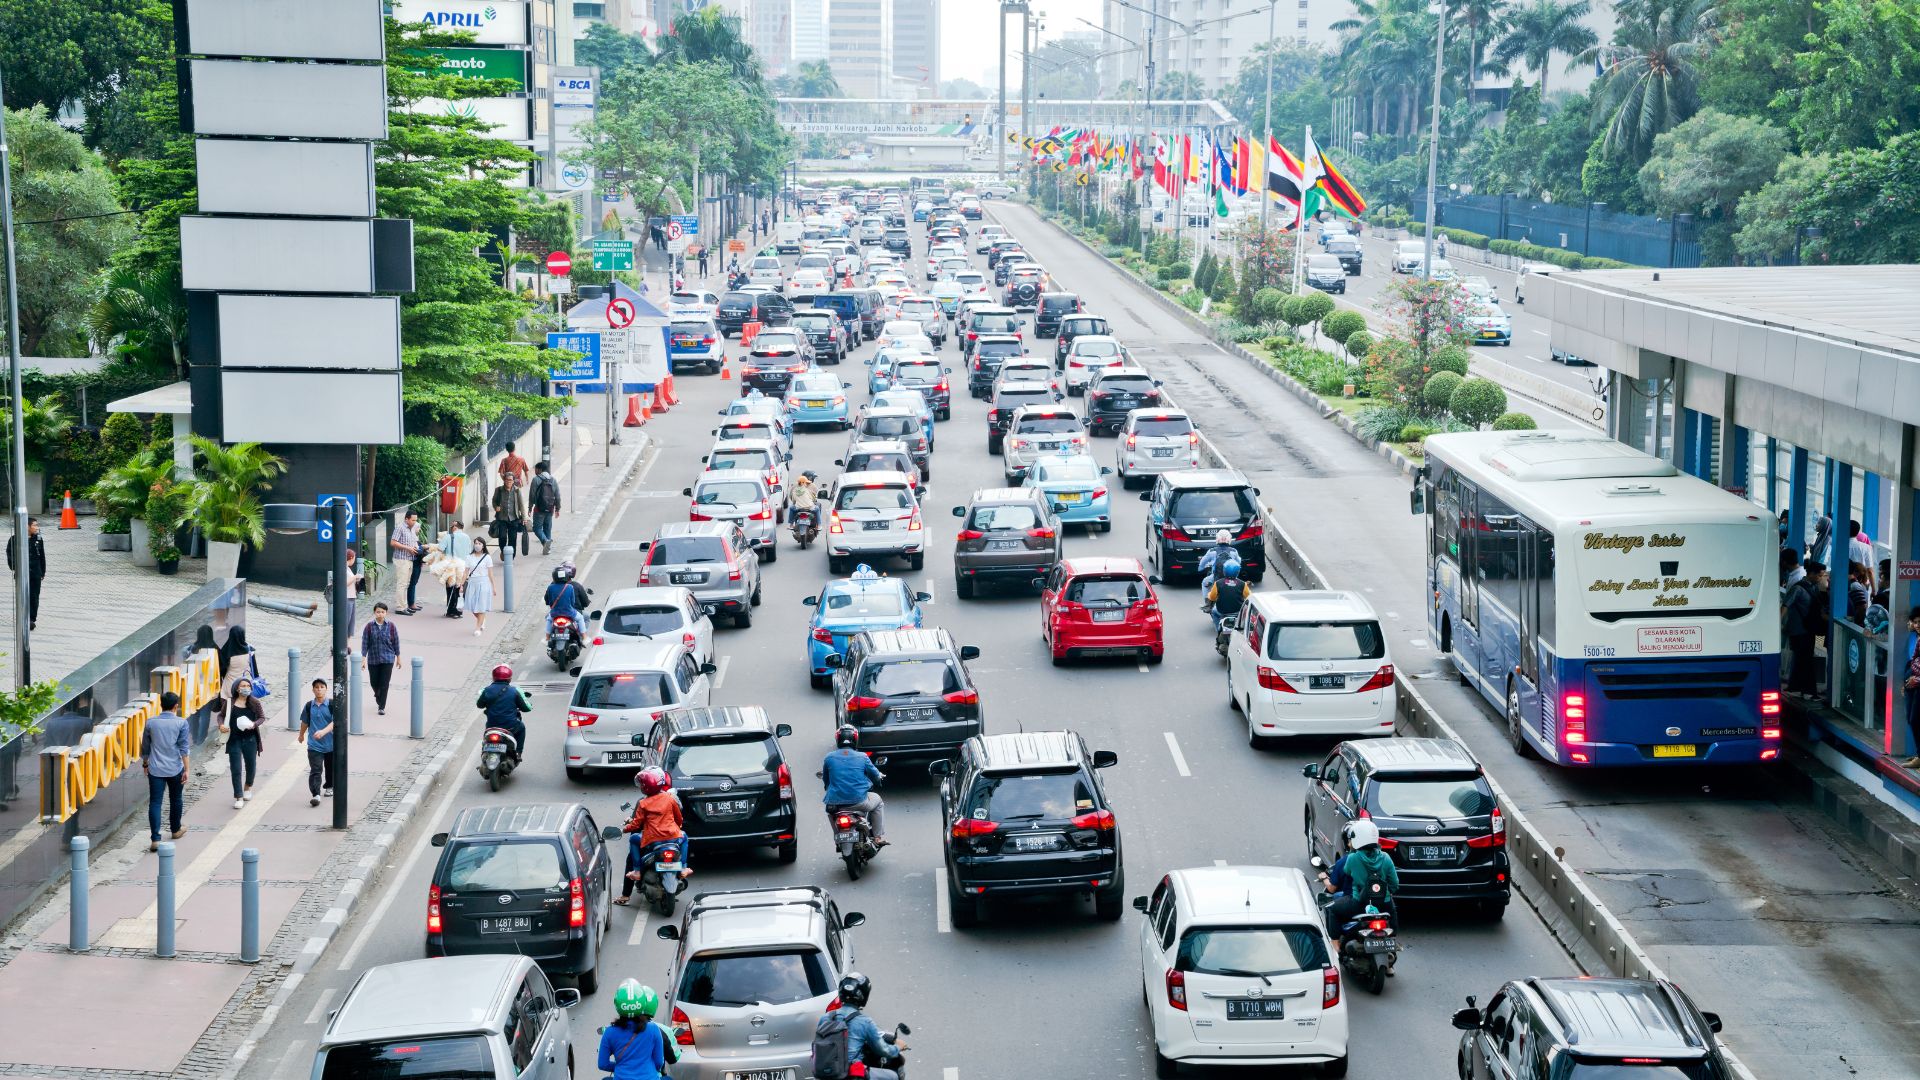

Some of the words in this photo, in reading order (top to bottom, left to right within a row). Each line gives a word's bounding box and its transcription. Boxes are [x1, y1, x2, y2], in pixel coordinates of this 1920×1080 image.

[422, 12, 483, 27] APRIL
[433, 53, 486, 68] anoto
[569, 80, 590, 89] BCA
[803, 124, 832, 132] Sayangi
[321, 529, 353, 540] OT
[1583, 533, 1645, 553] Vintage
[1648, 533, 1687, 548] Series
[1589, 580, 1625, 594] Bring
[1627, 578, 1659, 590] Back
[1663, 578, 1690, 592] Your
[1693, 576, 1752, 588] Memories
[1653, 595, 1689, 607] Inside
[1583, 647, 1615, 657] 1500-102
[1663, 643, 1701, 651] MENDAHULUI
[1740, 642, 1761, 652] TJ-321
[1702, 728, 1755, 736] Mercedes-Benz
[1016, 839, 1021, 847] B
[1410, 847, 1415, 856] B
[1422, 847, 1439, 856] 1059
[483, 920, 489, 929] B
[621, 1001, 642, 1011] Grab
[1228, 1002, 1235, 1012] B
[1241, 1001, 1260, 1012] 1710
